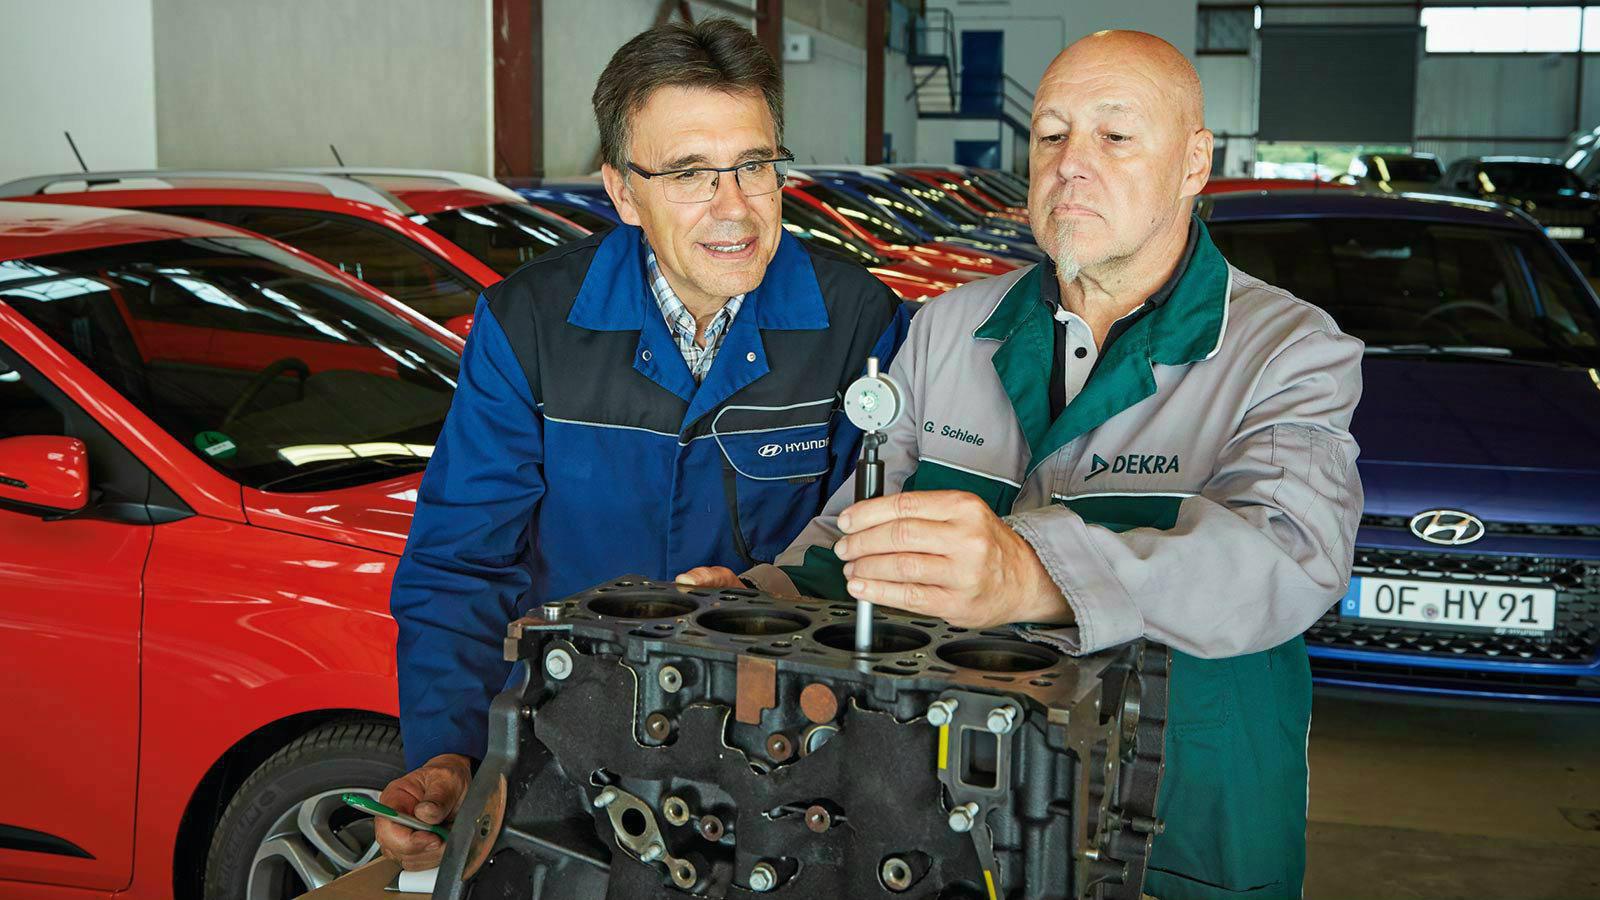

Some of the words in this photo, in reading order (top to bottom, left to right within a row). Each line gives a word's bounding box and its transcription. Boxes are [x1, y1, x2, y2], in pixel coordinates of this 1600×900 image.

[923, 420, 934, 433] G.
[940, 425, 984, 446] Schiele
[1111, 454, 1179, 475] DEKRA
[1374, 584, 1418, 615] OF
[1444, 589, 1488, 620] HY
[1498, 593, 1539, 624] 91
